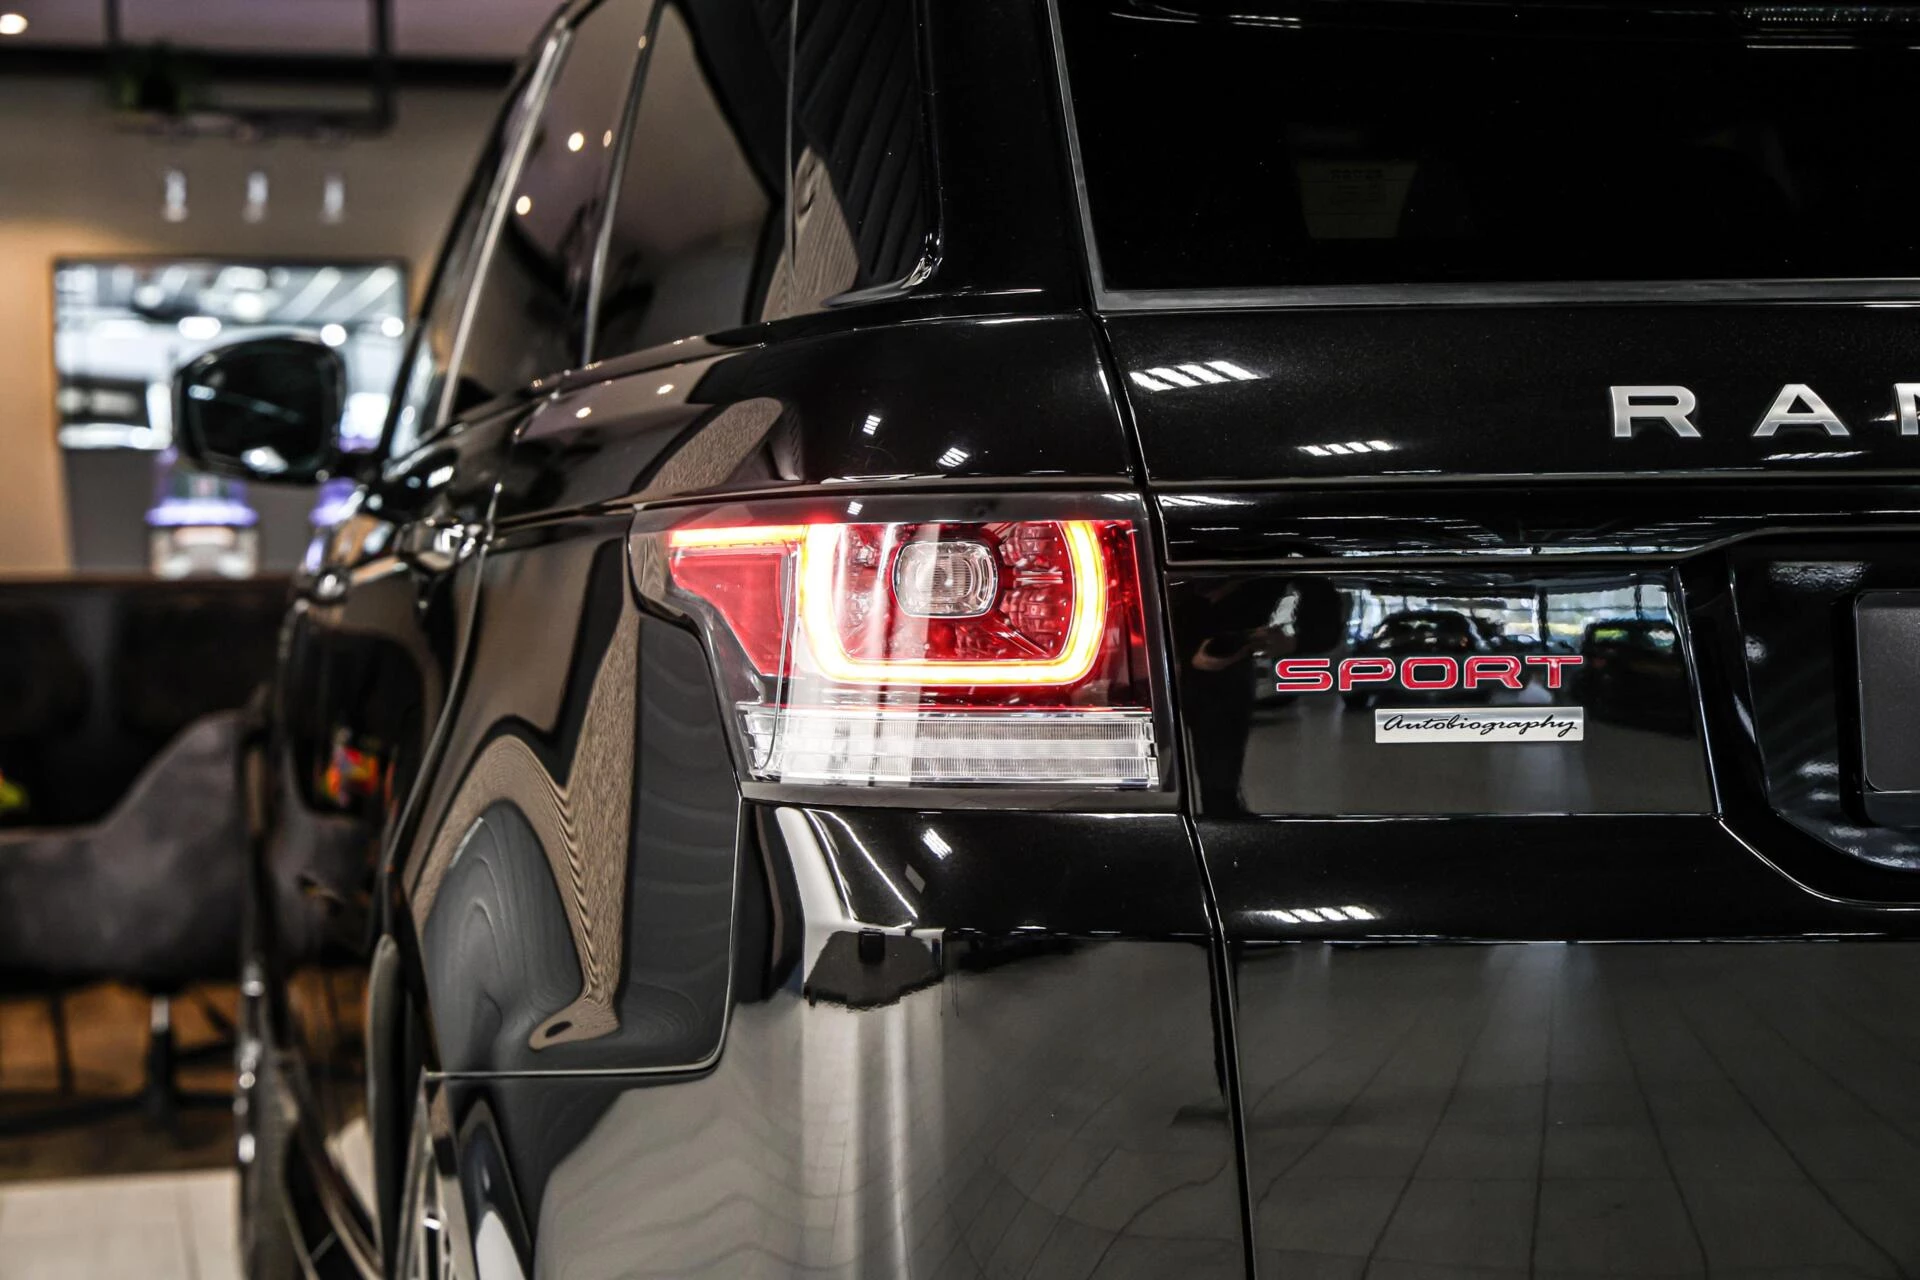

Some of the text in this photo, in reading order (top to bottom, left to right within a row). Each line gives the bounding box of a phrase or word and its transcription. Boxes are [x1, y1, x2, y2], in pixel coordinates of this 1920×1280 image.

[1609, 383, 1920, 438] RA
[1275, 655, 1584, 692] SPORT
[1383, 714, 1578, 738] Autobiography
